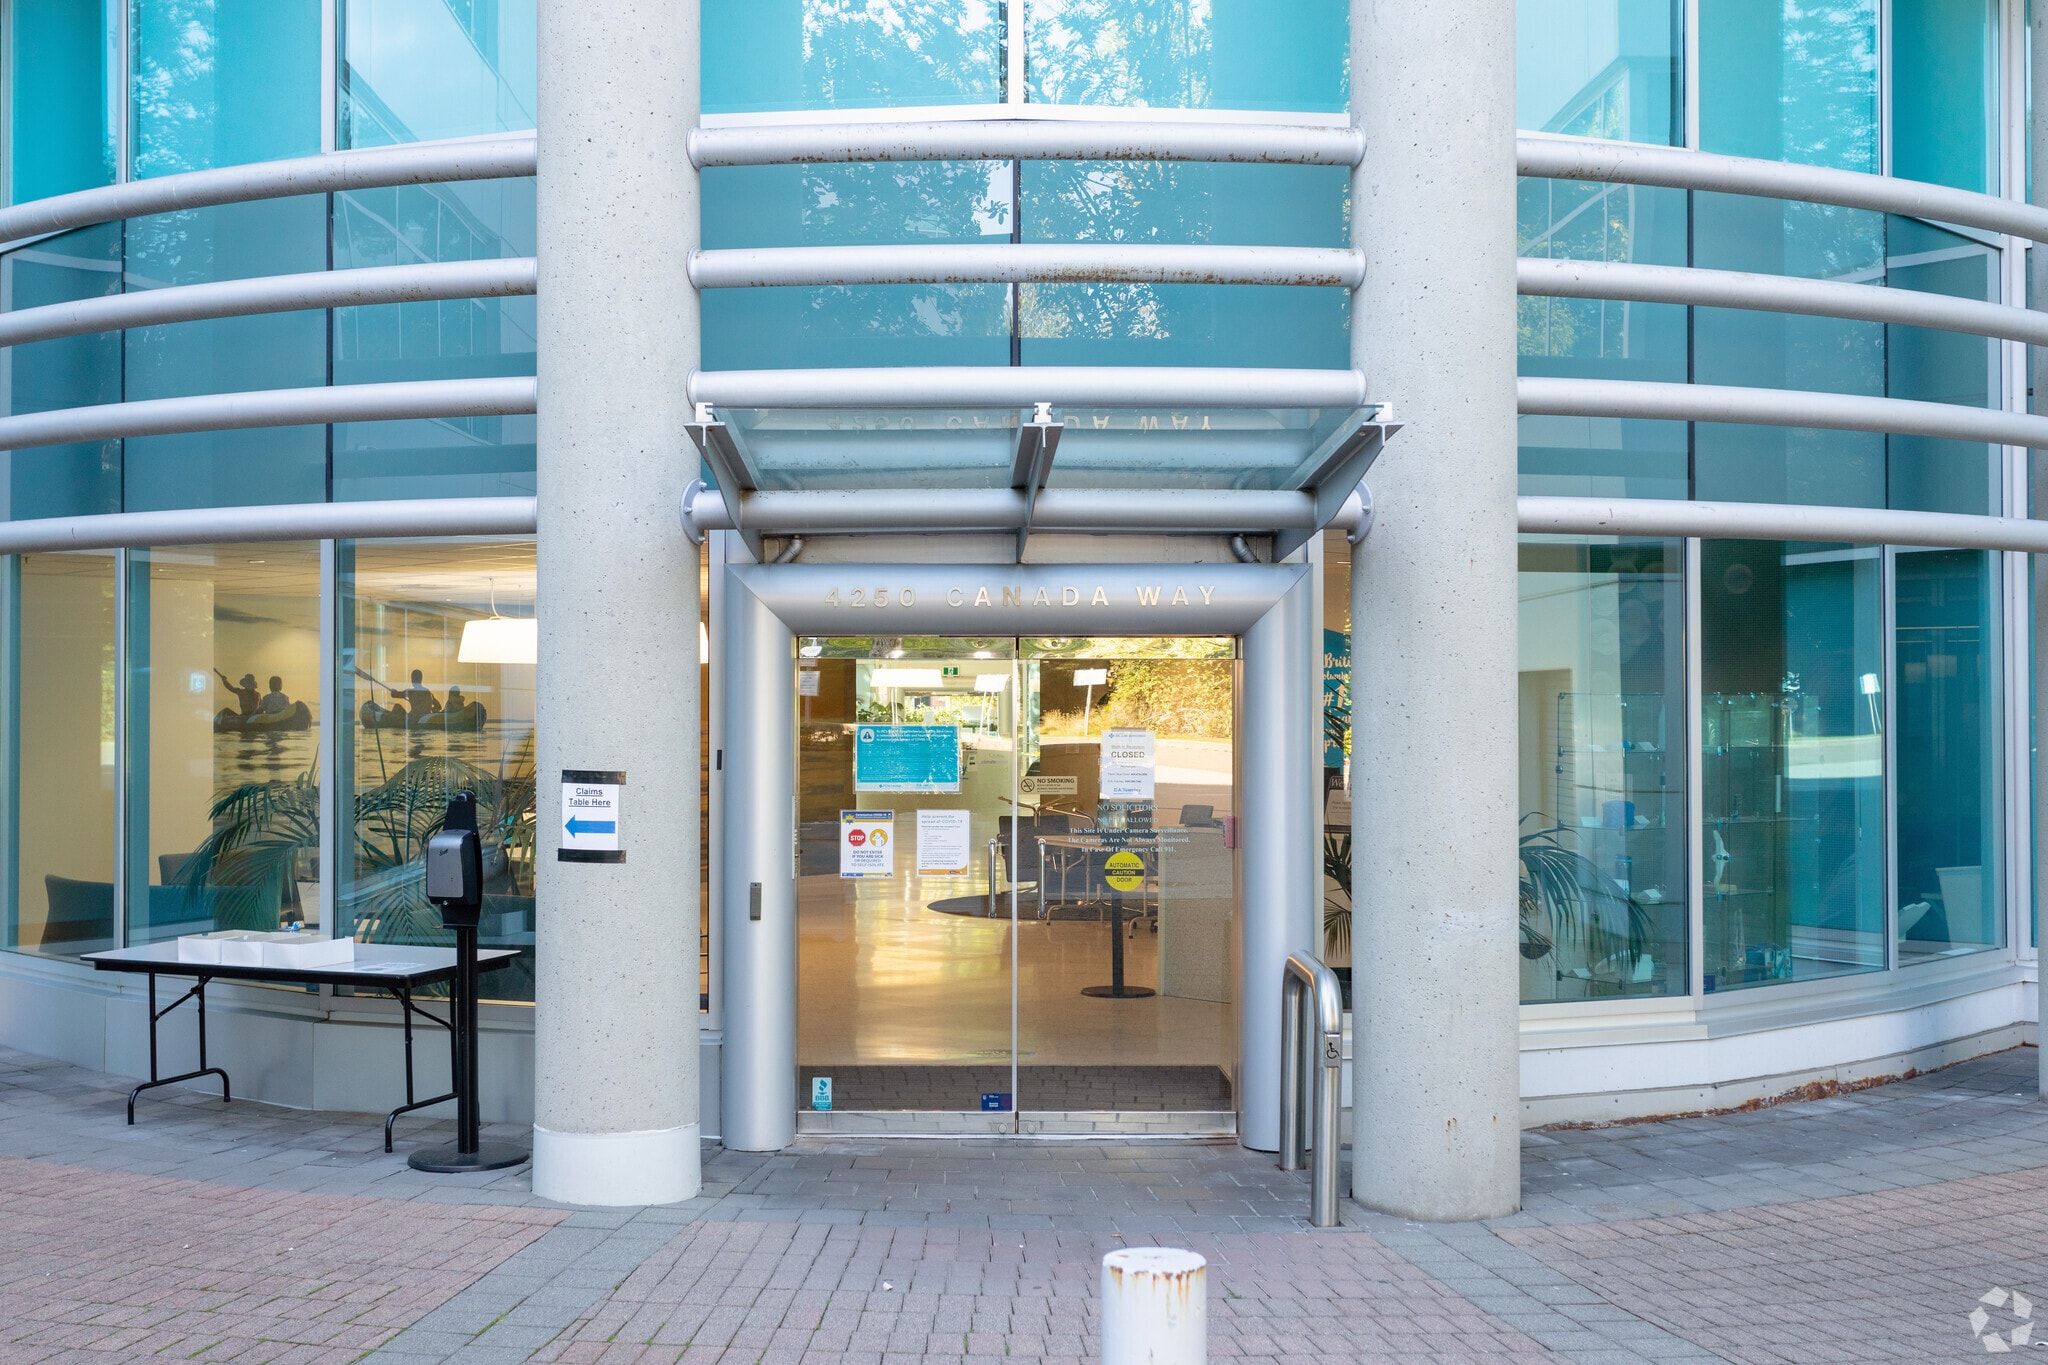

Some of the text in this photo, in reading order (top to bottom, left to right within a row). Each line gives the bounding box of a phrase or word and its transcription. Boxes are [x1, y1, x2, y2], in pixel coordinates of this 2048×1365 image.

[824, 586, 1216, 607] 4250 CANADA WAY
[1323, 652, 1351, 668] Briti
[575, 787, 603, 795] Claims
[568, 798, 590, 806] Table
